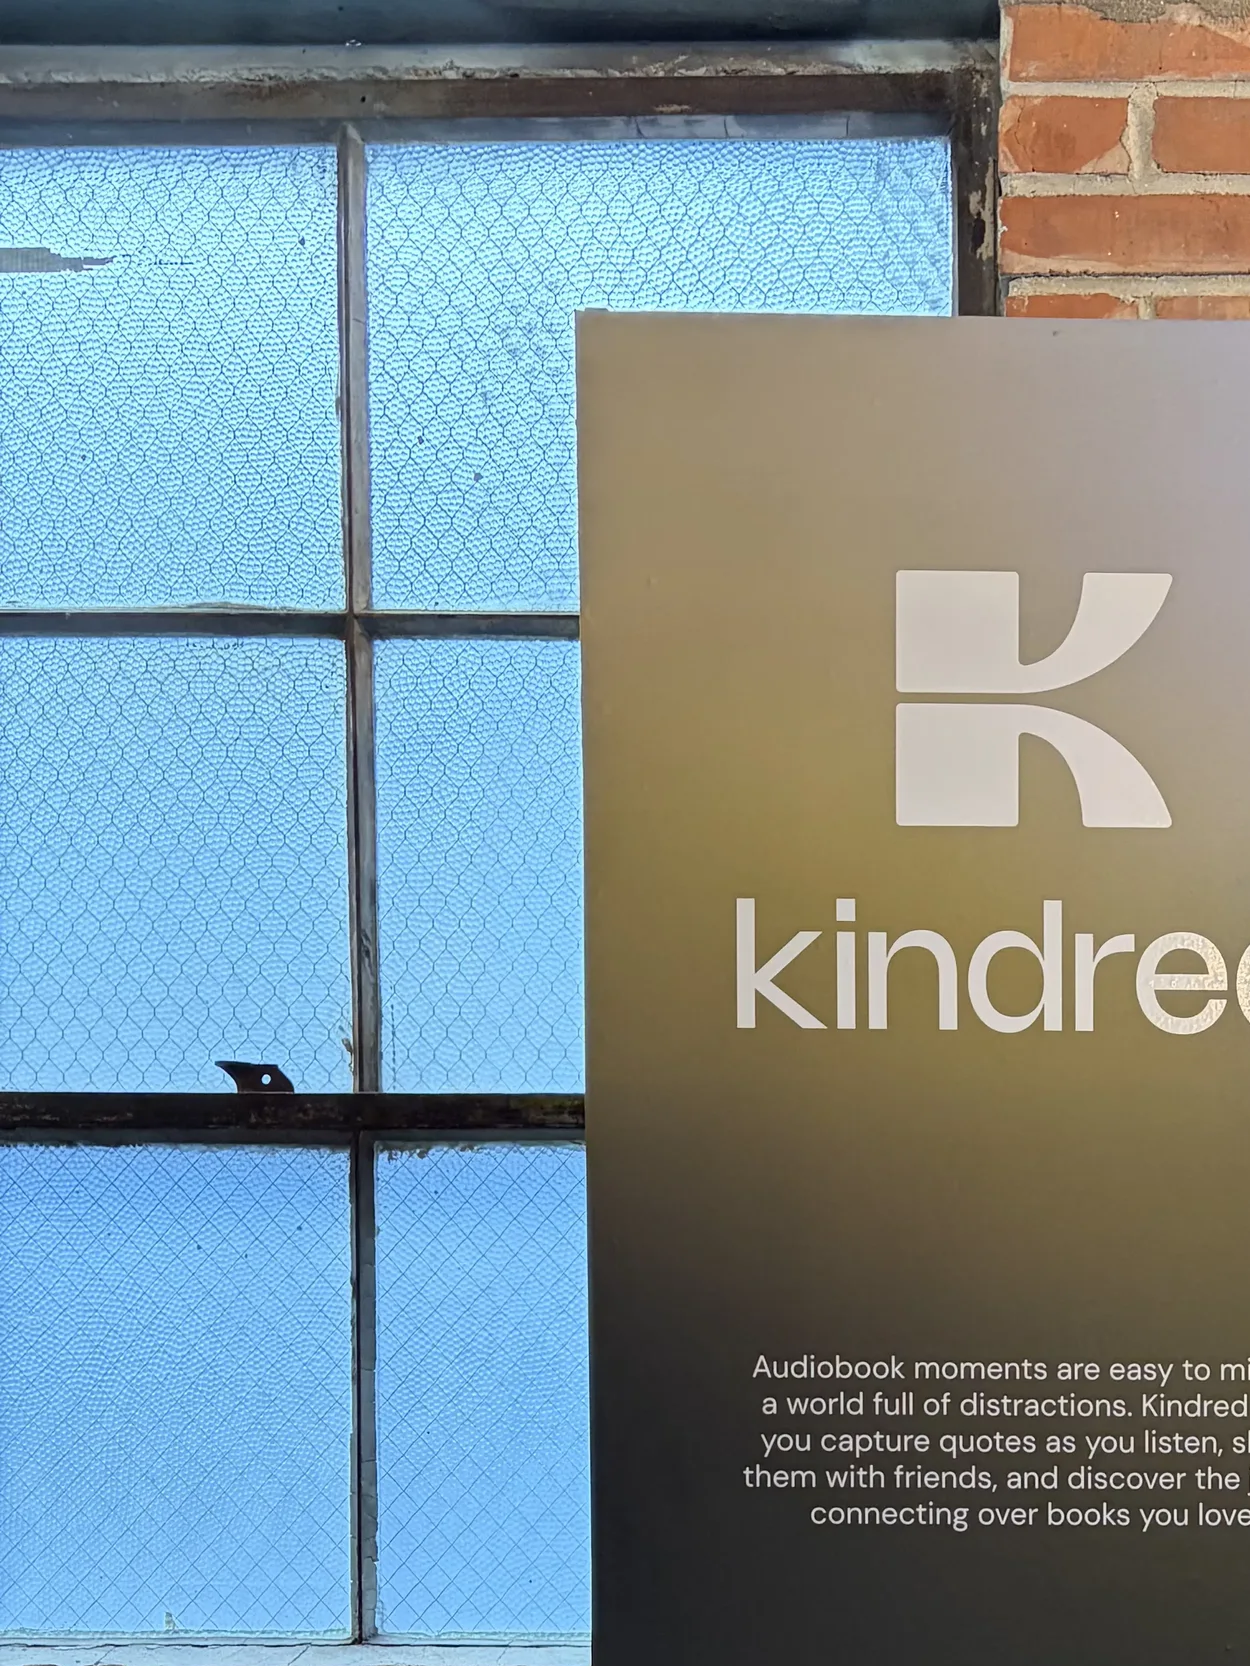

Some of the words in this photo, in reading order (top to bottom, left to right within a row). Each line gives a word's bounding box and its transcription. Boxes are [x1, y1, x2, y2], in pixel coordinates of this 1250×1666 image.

[752, 1354, 905, 1380] Audiobook
[914, 1358, 1048, 1381] moments
[1056, 1362, 1101, 1381] are
[1109, 1362, 1174, 1388] easy
[1182, 1359, 1211, 1381] to
[761, 1396, 778, 1415] a
[786, 1391, 864, 1416] world
[872, 1391, 914, 1416] full
[923, 1391, 951, 1416] of
[959, 1391, 1133, 1418] distractions.
[1142, 1393, 1248, 1418] Kindred
[760, 1433, 811, 1458] you
[820, 1430, 930, 1459] capture
[939, 1431, 1037, 1459] quotes
[1045, 1435, 1077, 1454] as
[1085, 1435, 1135, 1460] you
[1144, 1429, 1223, 1458] listen,
[742, 1463, 817, 1488] them
[825, 1464, 885, 1489] with
[893, 1464, 998, 1493] friends,
[1006, 1465, 1058, 1490] and
[1067, 1465, 1187, 1490] discover
[1194, 1465, 1241, 1491] the
[810, 1500, 970, 1533] connecting
[978, 1507, 1039, 1526] over
[1047, 1501, 1131, 1526] books
[1139, 1508, 1189, 1533] you
